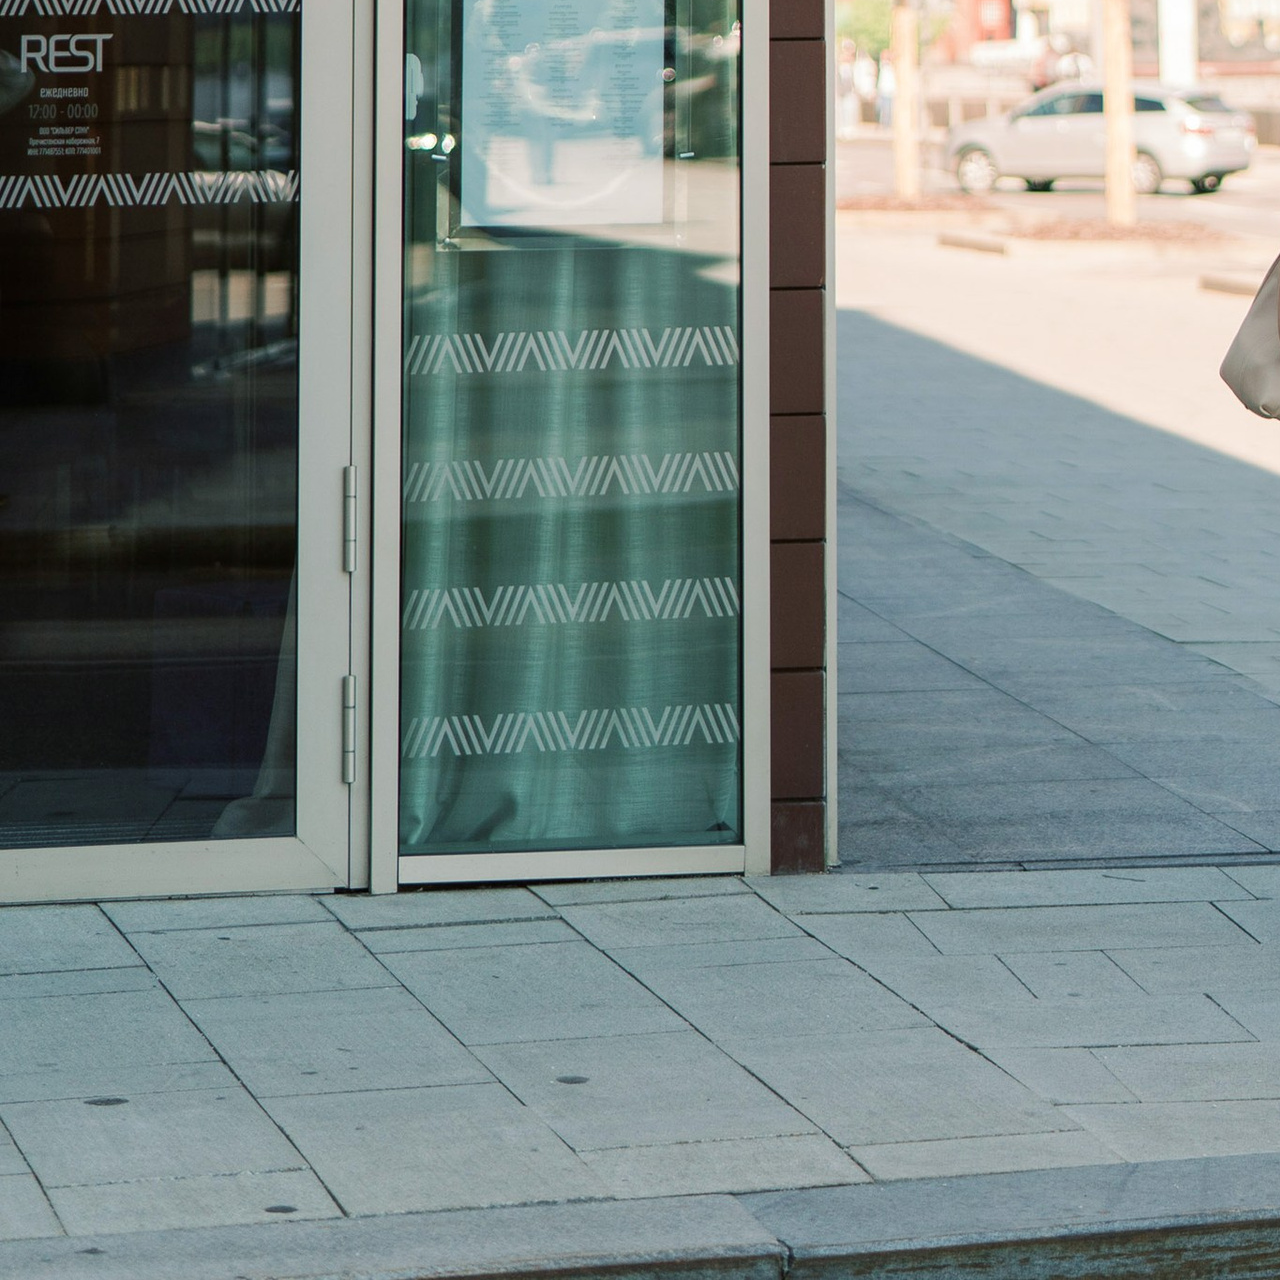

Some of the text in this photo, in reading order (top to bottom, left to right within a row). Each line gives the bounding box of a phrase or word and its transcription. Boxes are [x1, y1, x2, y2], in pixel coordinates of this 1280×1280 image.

[21, 34, 114, 73] REST
[40, 87, 89, 98] ежедневно
[67, 104, 98, 118] 00:00
